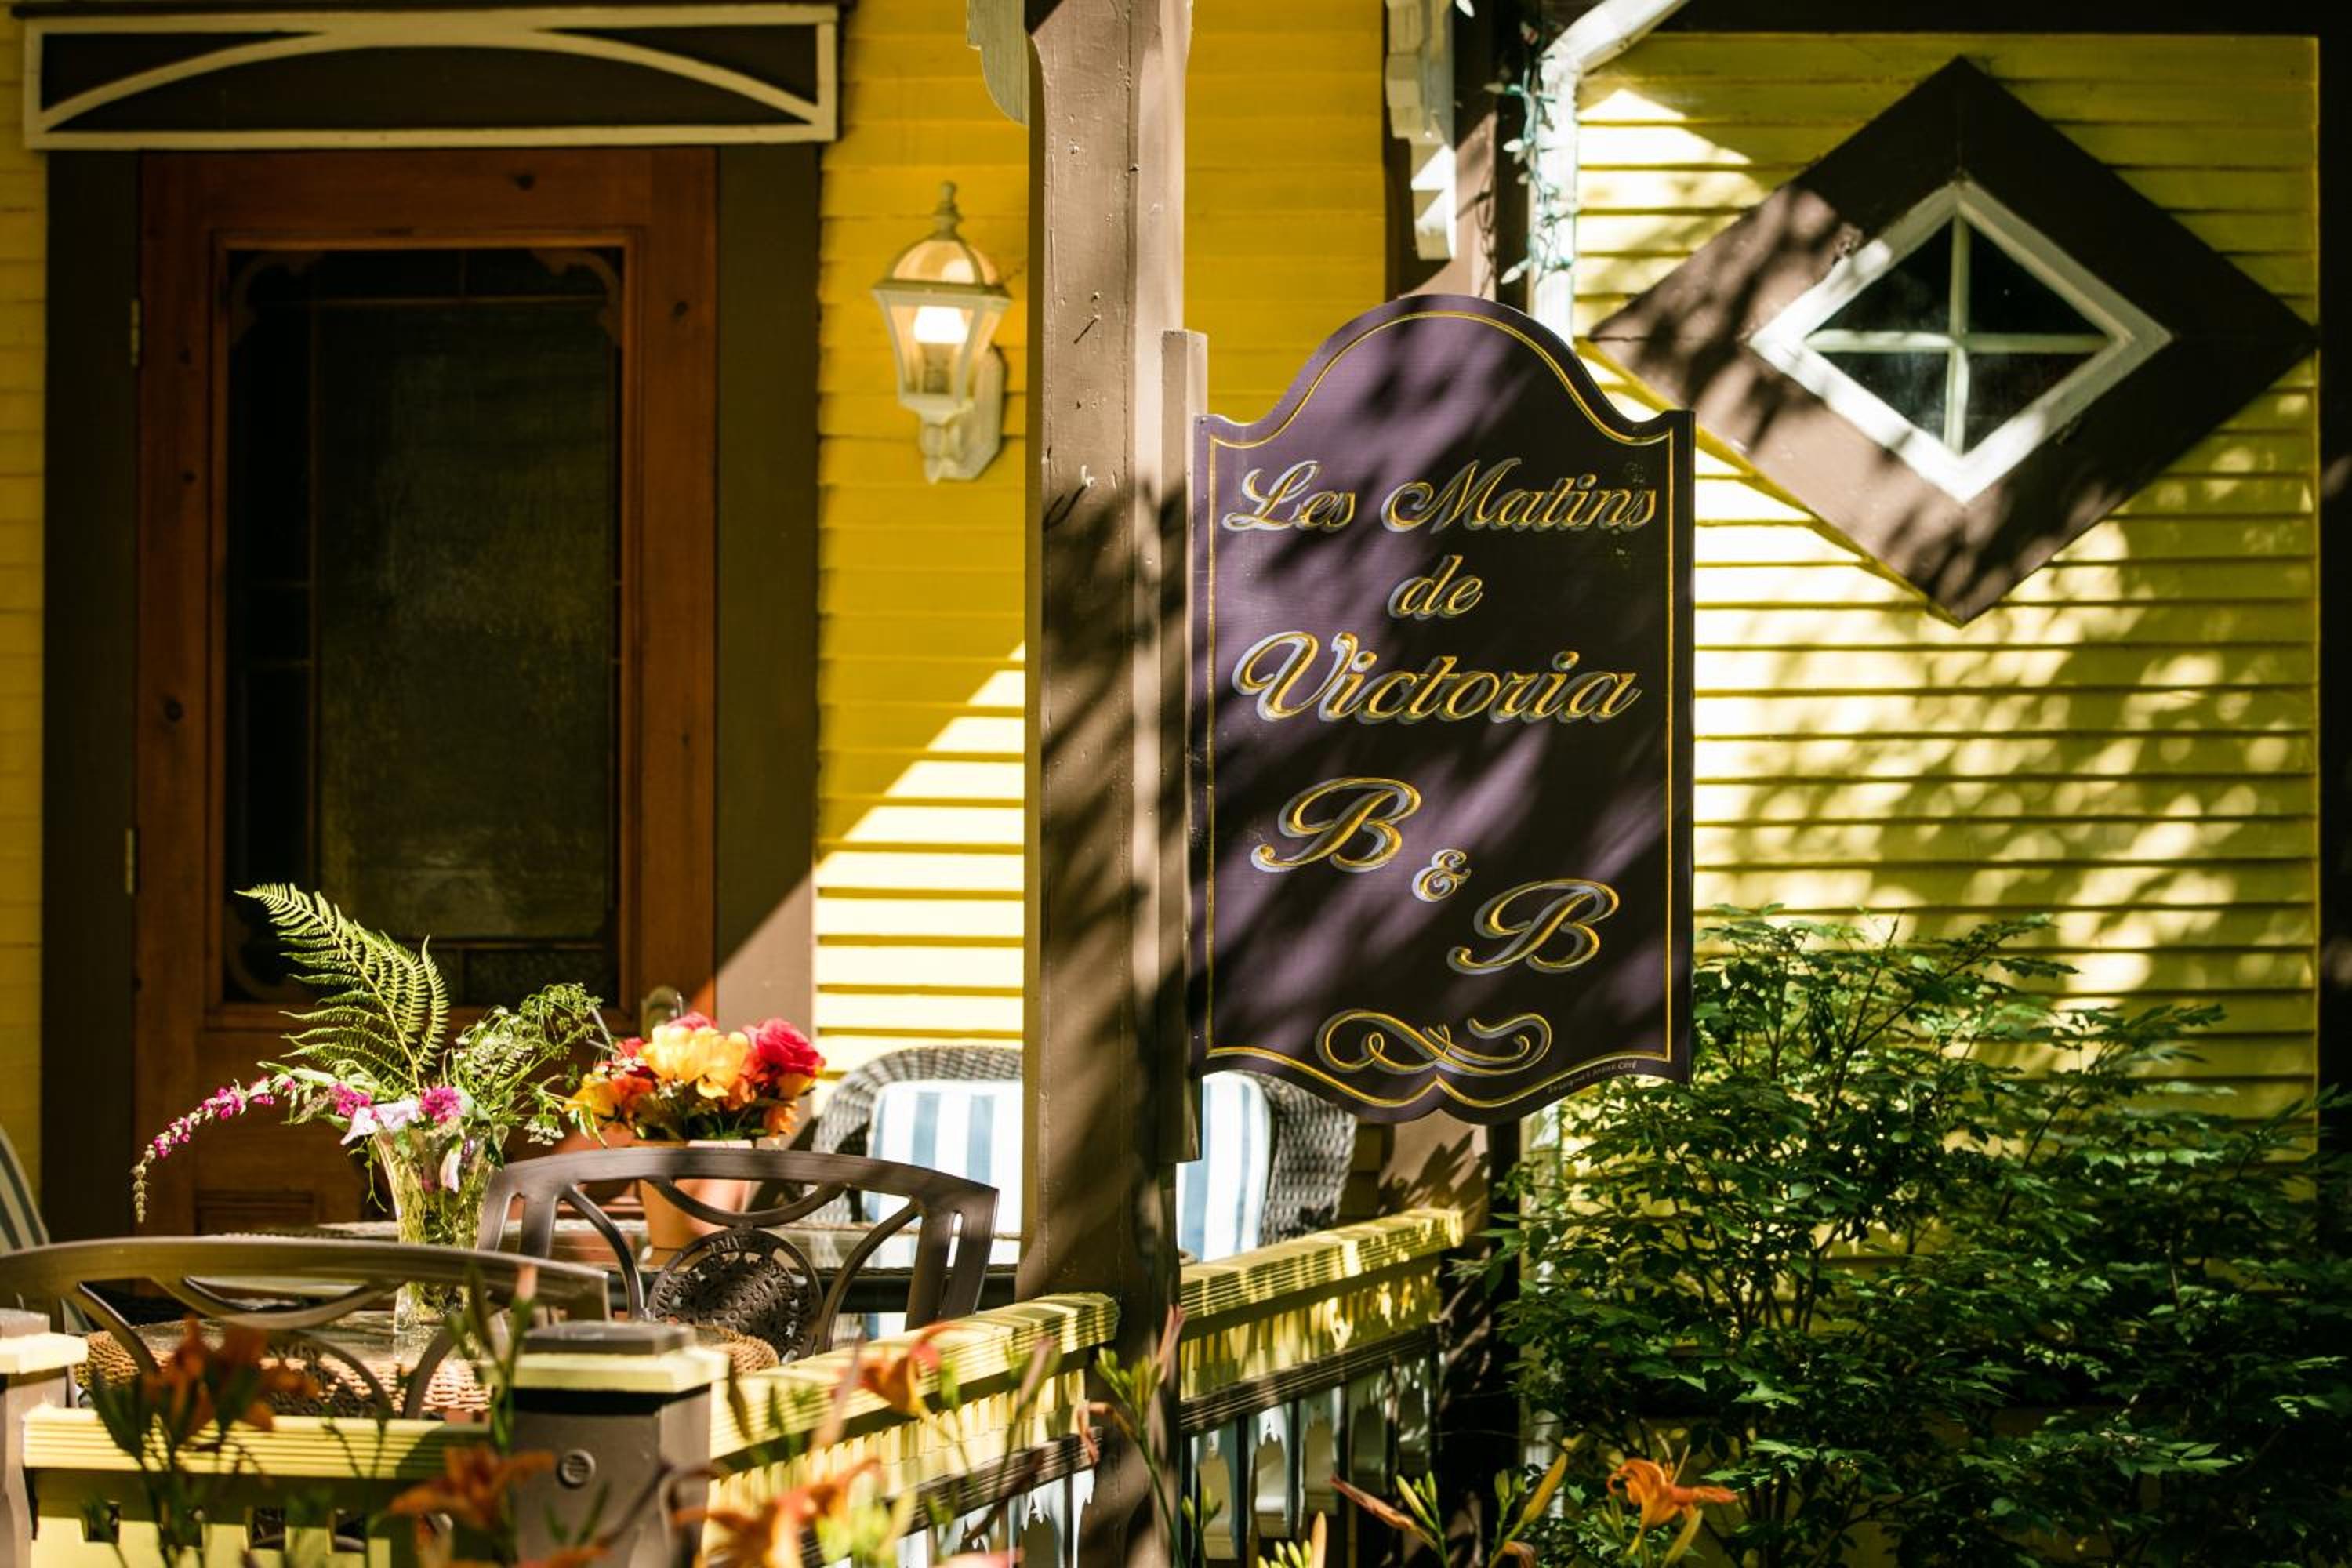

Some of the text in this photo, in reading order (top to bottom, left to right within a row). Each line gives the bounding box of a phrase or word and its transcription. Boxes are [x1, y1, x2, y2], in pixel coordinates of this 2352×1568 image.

[1221, 457, 1656, 534] Les Matins
[1388, 555, 1484, 619] de
[1232, 630, 1642, 723] Victoria
[1251, 777, 1619, 975] B & B
